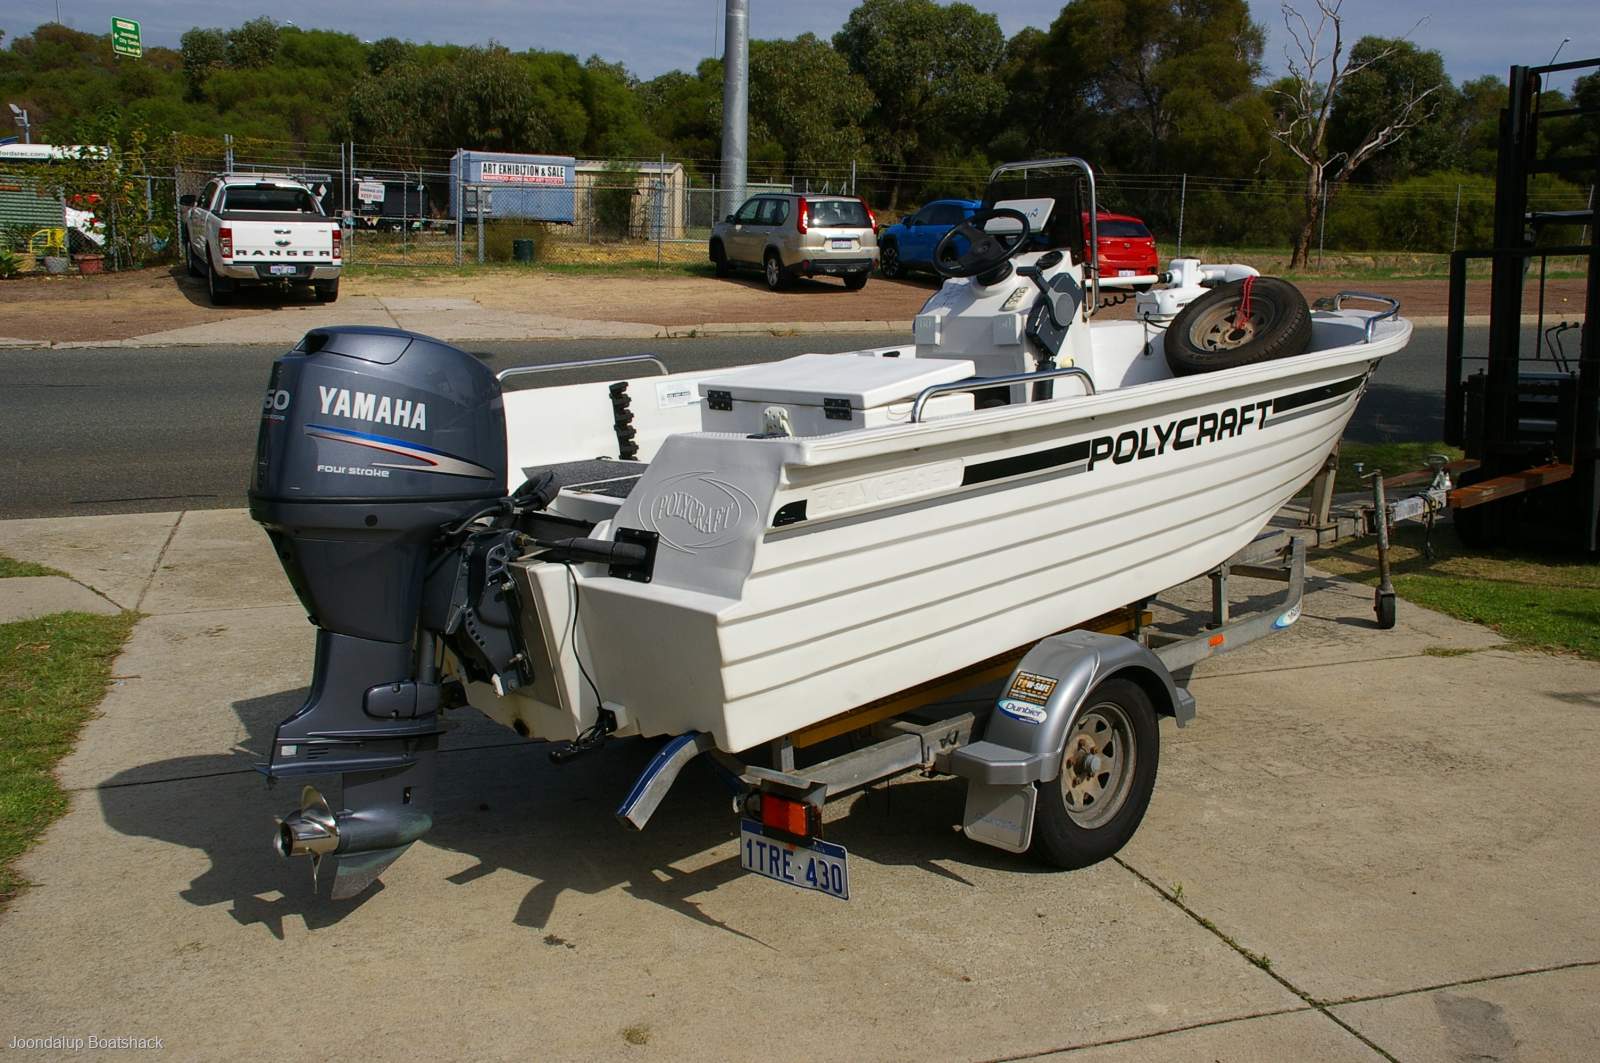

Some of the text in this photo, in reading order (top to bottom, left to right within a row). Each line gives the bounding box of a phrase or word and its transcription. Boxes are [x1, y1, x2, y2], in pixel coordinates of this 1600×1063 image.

[482, 163, 564, 178] ART EXHIBITION & SALE
[319, 385, 426, 431] YAMAHA
[1086, 400, 1273, 472] POLYCRAFT
[657, 491, 732, 534] POLYCRAFT
[1006, 702, 1041, 717] Dunbier
[806, 857, 843, 894] 430
